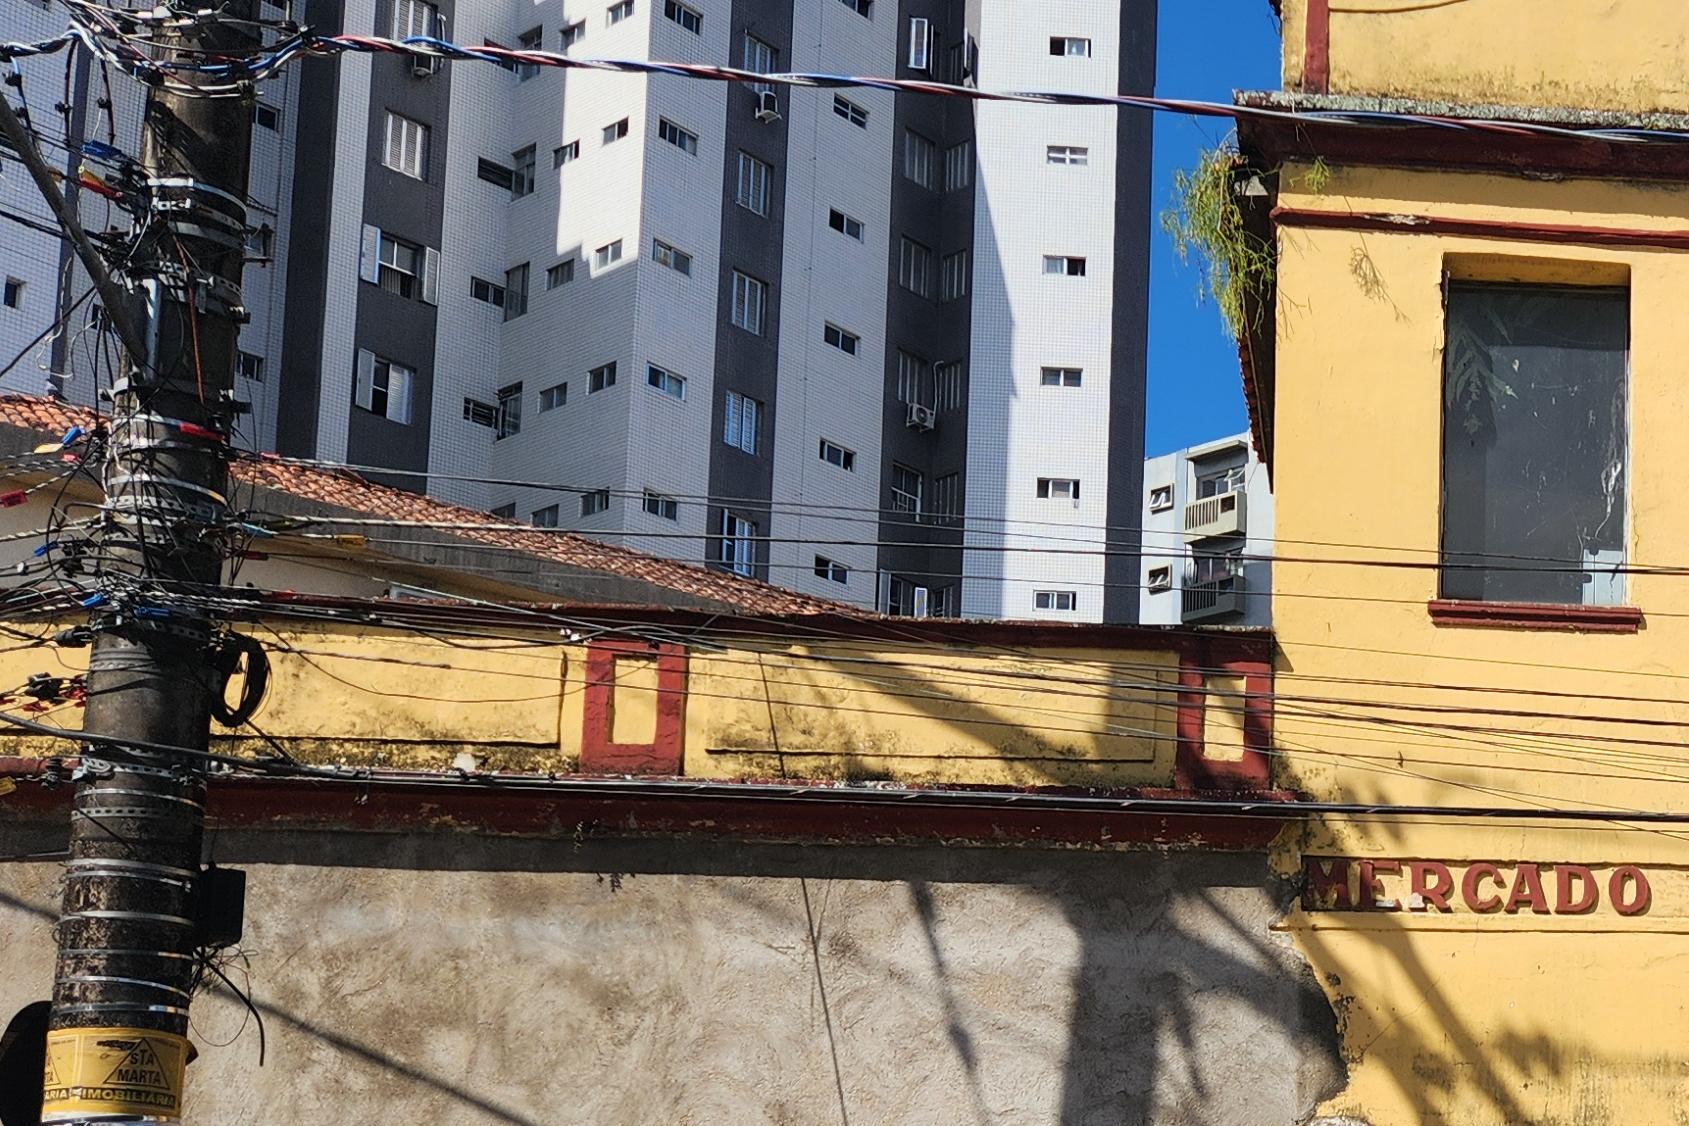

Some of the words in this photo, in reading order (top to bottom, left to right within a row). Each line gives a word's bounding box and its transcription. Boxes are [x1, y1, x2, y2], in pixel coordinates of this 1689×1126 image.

[1304, 859, 1652, 916] MERCADO
[130, 1049, 154, 1066] STA
[117, 1068, 161, 1085] MARTA
